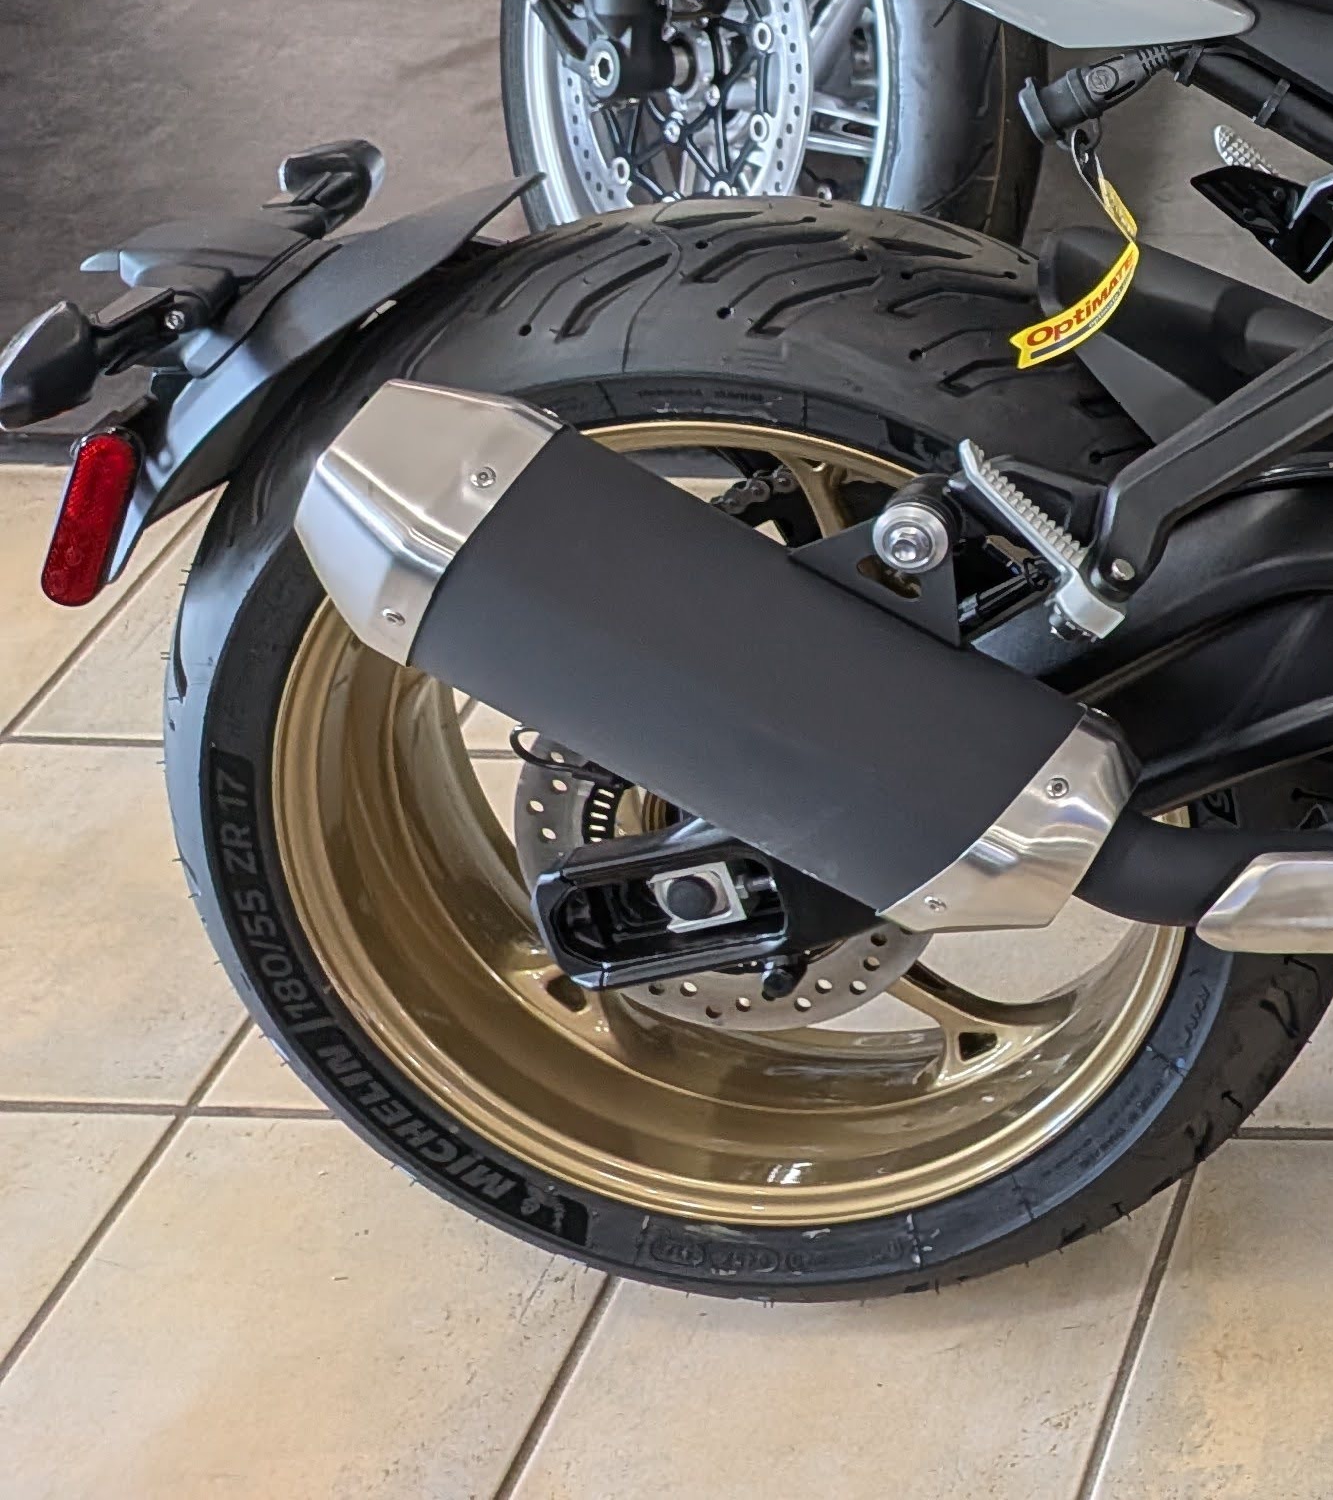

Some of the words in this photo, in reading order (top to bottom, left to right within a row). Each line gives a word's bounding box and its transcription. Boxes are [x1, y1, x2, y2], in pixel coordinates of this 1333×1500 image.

[1026, 252, 1135, 347] OptiMATE
[213, 770, 248, 810] 17
[223, 823, 257, 870] ZR
[236, 899, 310, 1034] 180/55
[315, 1036, 518, 1202] MICHELIN
